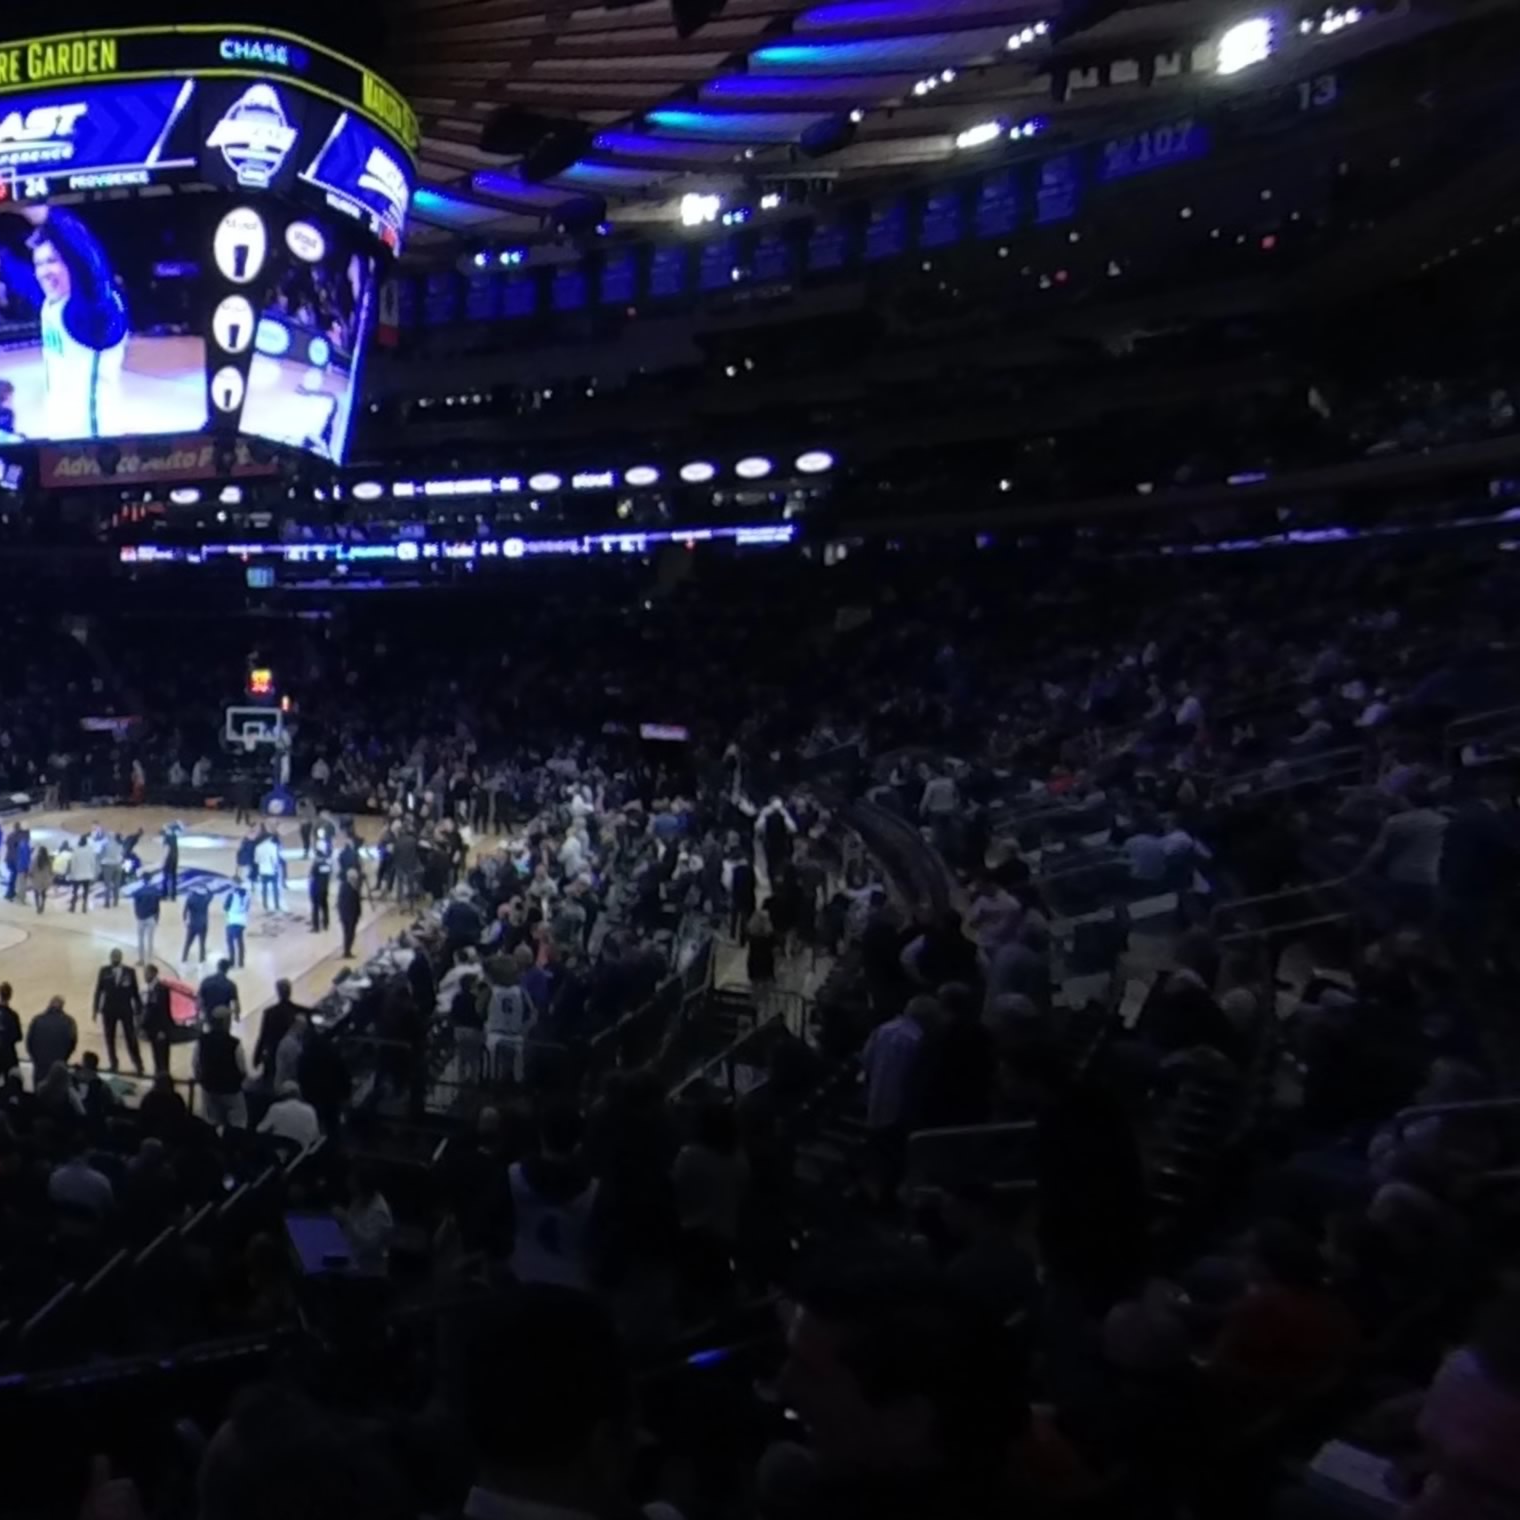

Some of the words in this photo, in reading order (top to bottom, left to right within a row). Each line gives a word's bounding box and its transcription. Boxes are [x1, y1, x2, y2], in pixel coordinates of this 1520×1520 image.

[28, 38, 117, 80] GARDEN
[220, 38, 288, 66] CHASE
[1296, 73, 1337, 111] 13
